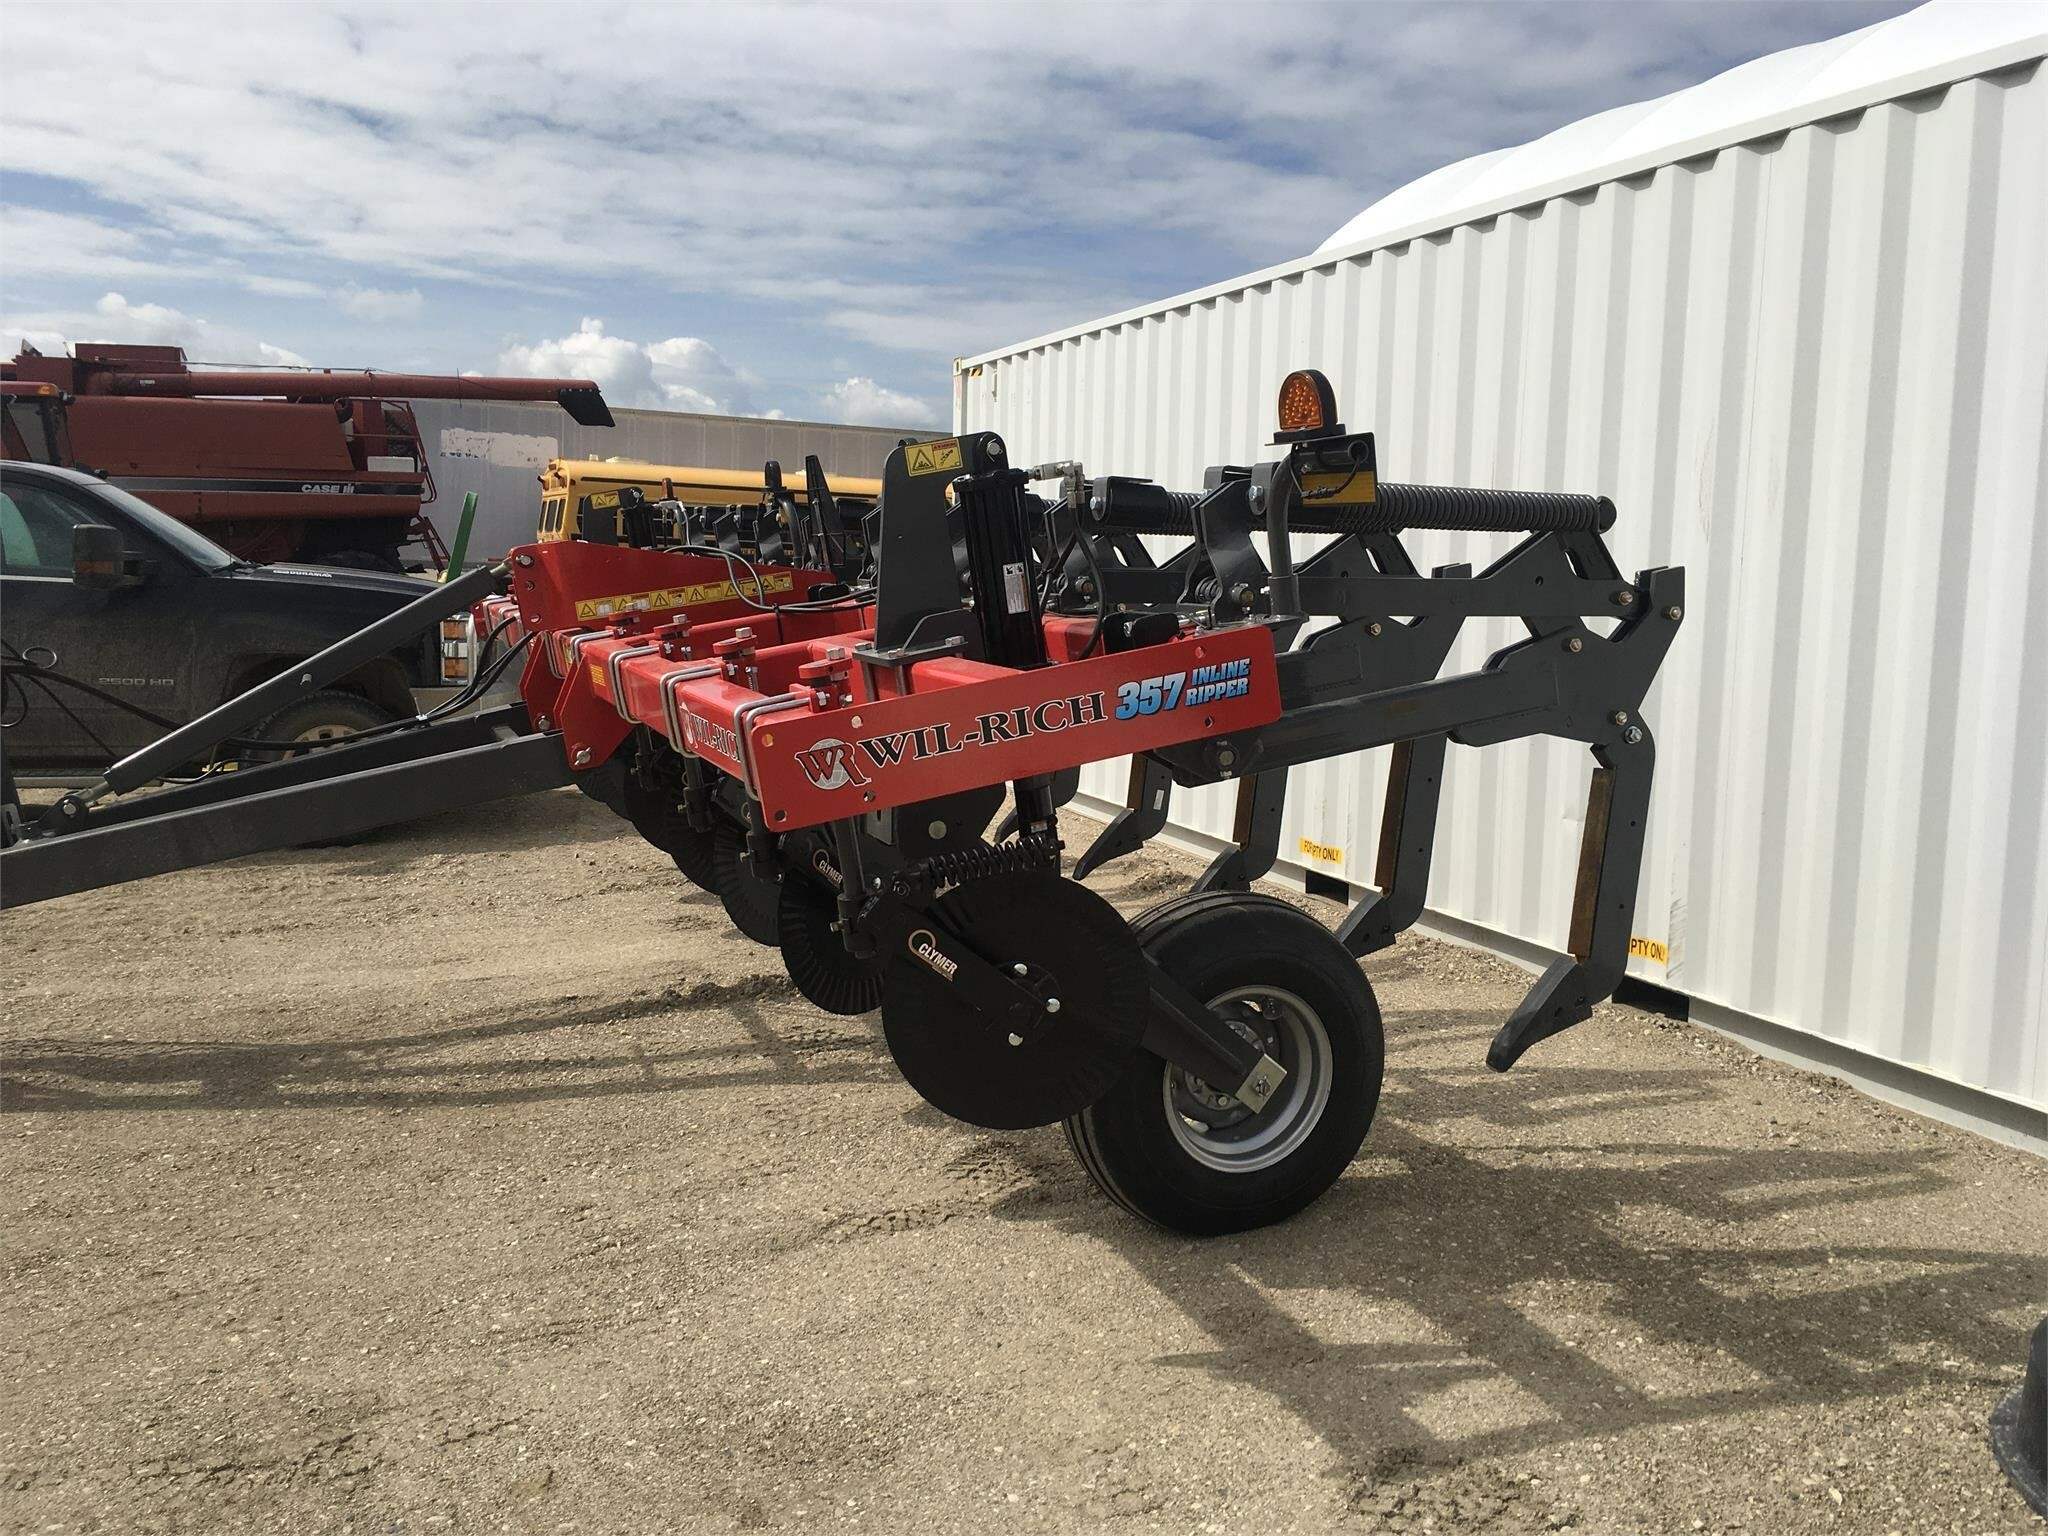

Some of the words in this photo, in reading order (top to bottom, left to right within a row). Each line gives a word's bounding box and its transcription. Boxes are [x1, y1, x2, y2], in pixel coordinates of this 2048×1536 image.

[301, 484, 340, 493] CASE
[99, 677, 145, 686] 2500
[1192, 658, 1251, 686] INLINE
[1115, 671, 1187, 720] 357
[1185, 677, 1249, 706] RIPPER
[857, 691, 1107, 768] WIL-RICH
[819, 860, 843, 884] CLYMER
[918, 943, 958, 975] CLYMER
[1630, 938, 1650, 956] PTY
